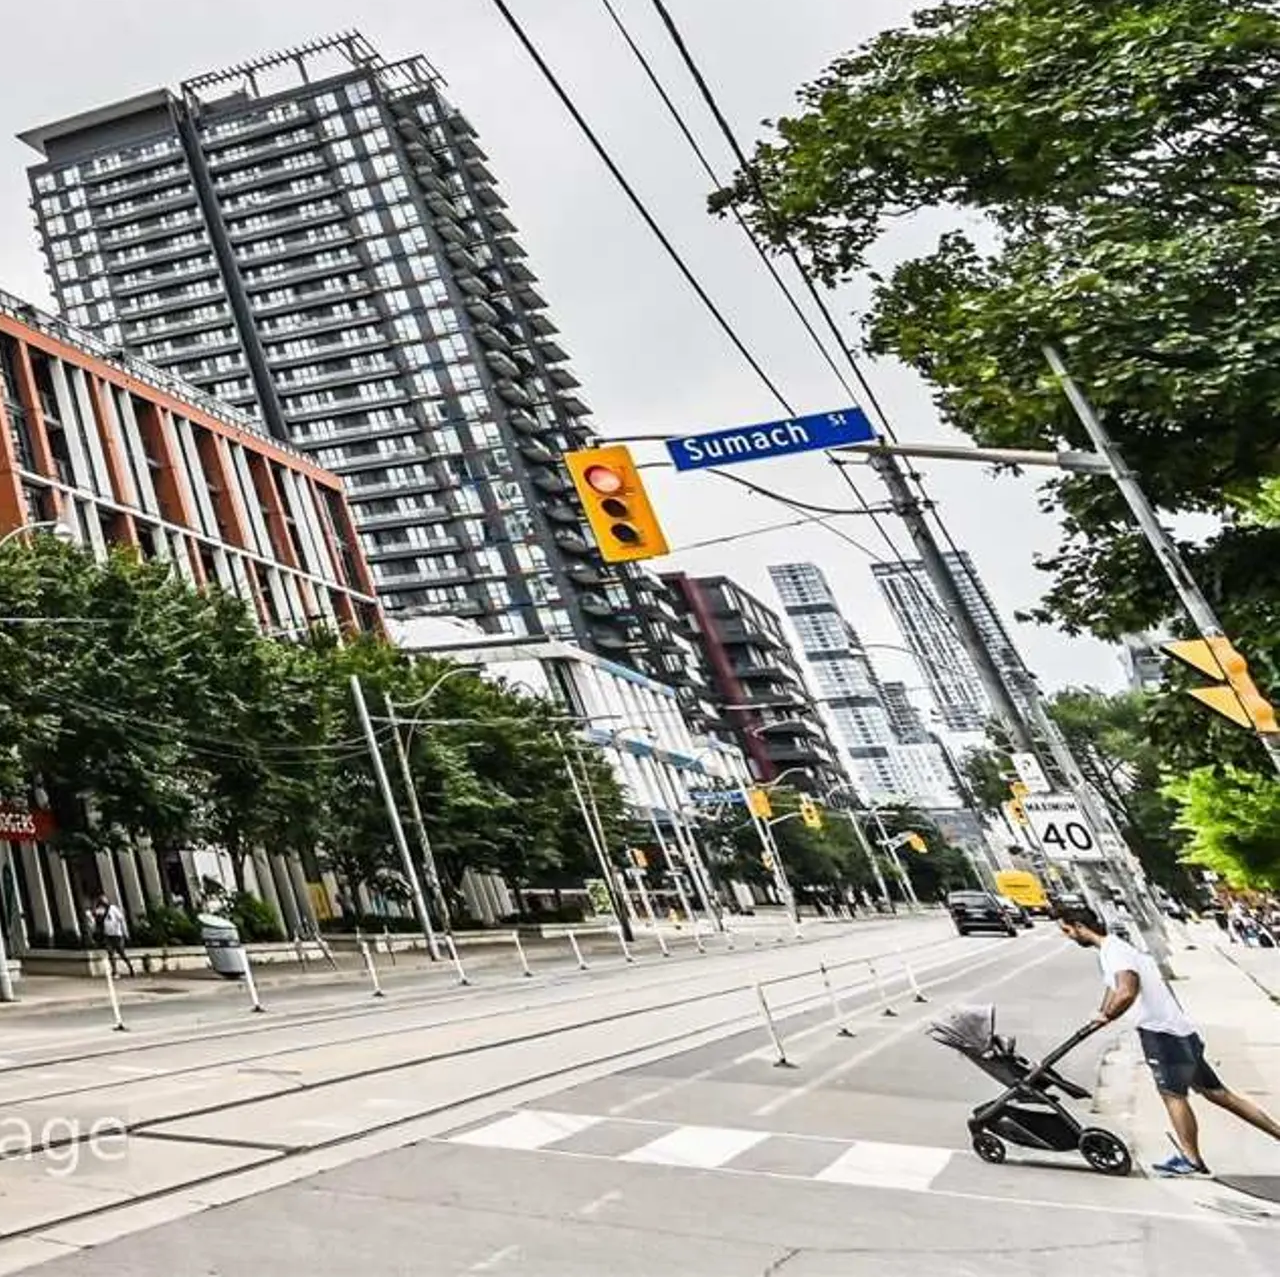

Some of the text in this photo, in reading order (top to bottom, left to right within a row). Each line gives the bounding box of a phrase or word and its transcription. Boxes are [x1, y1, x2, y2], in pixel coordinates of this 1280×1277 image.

[683, 413, 847, 461] Sumach St
[1043, 822, 1092, 851] 40
